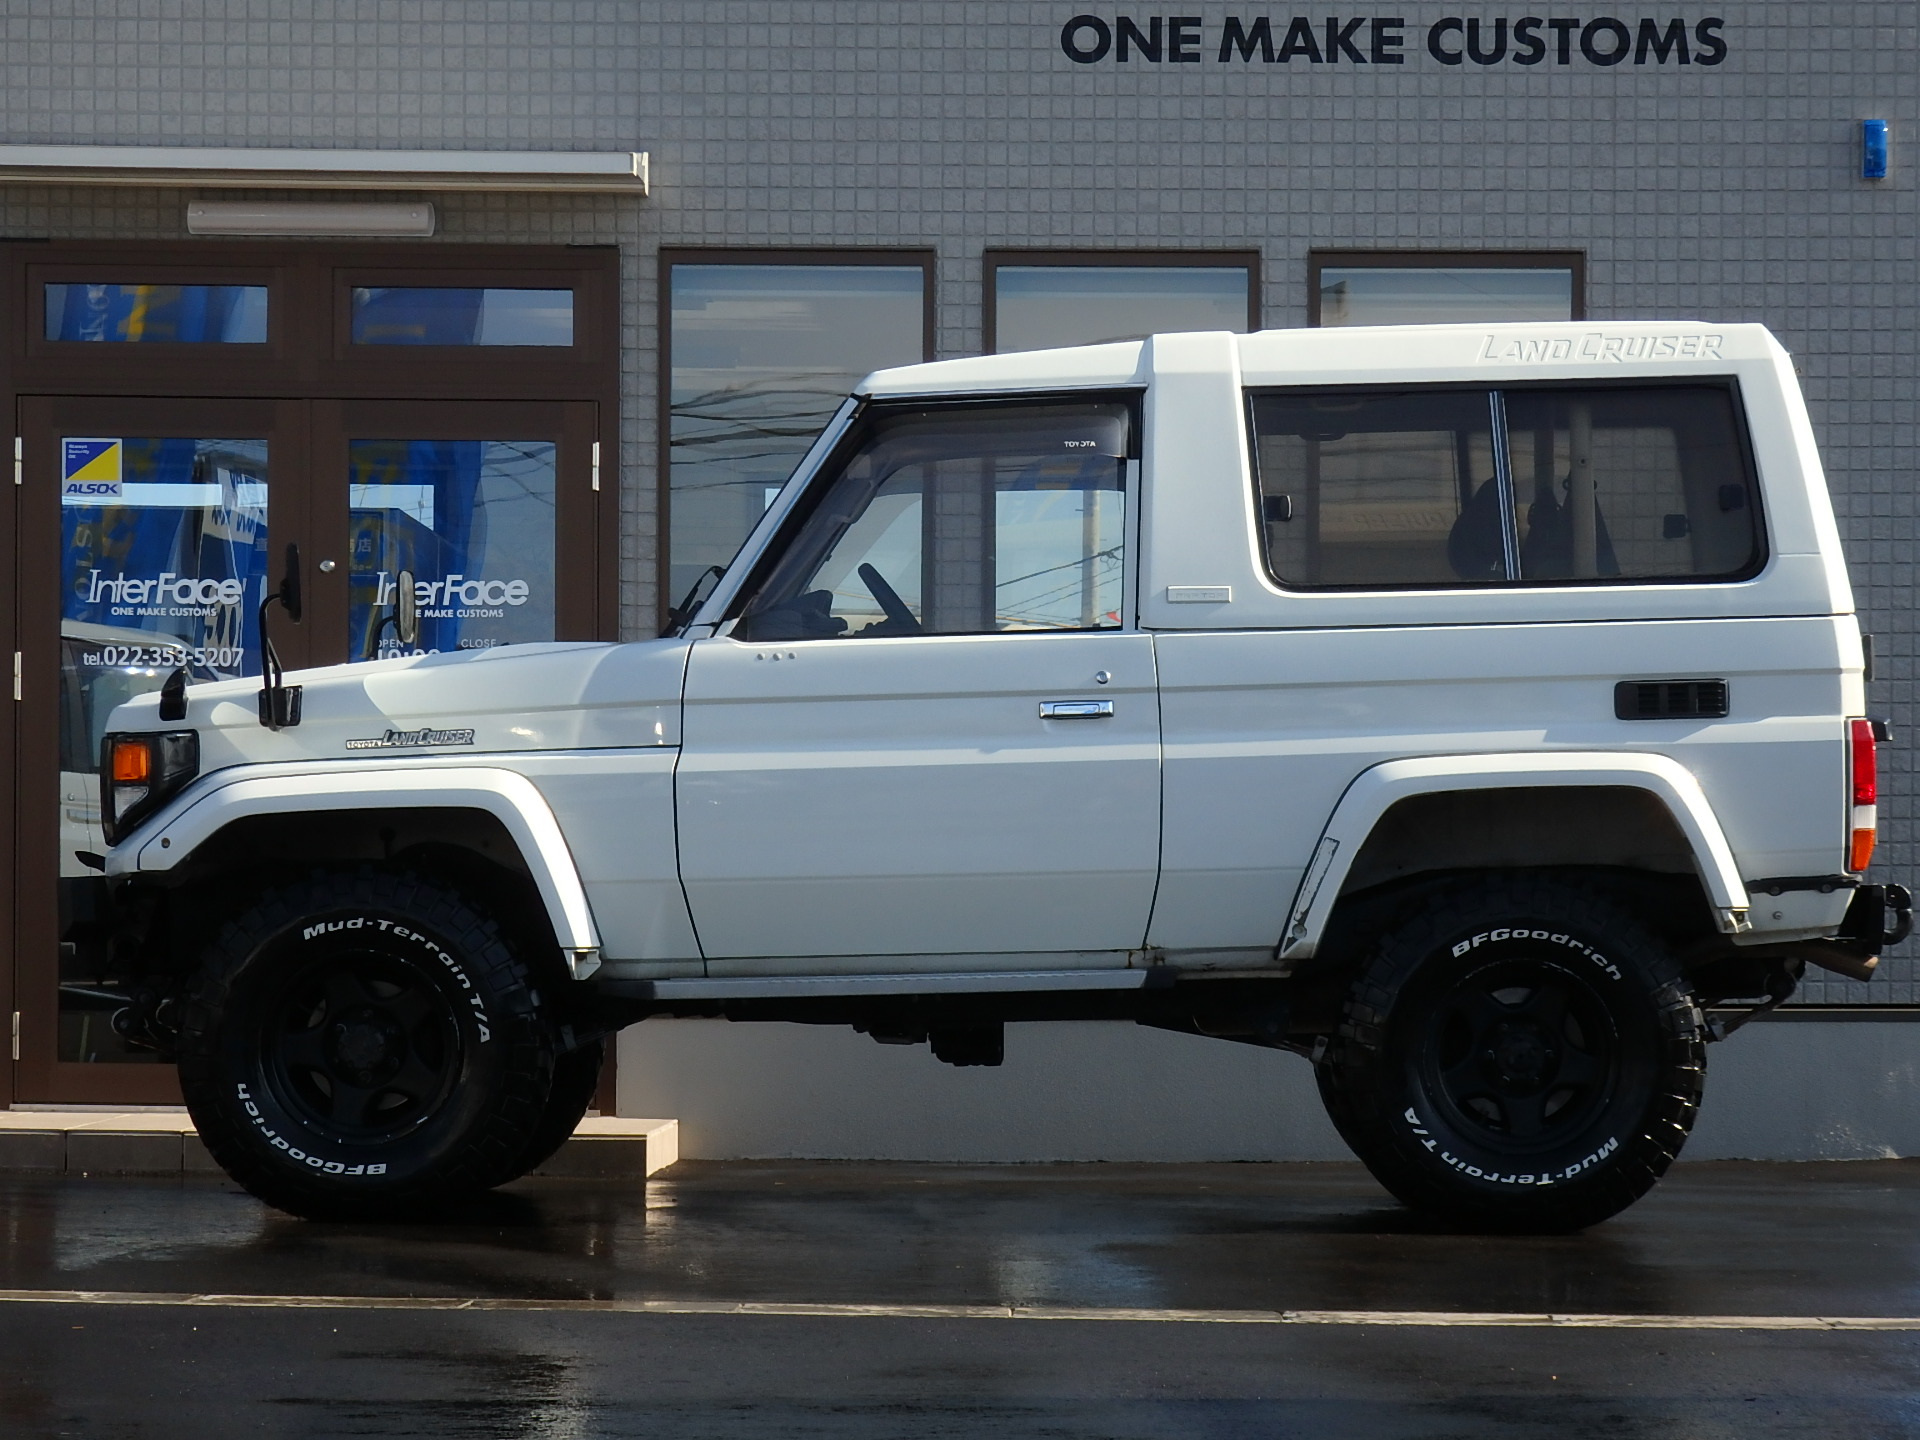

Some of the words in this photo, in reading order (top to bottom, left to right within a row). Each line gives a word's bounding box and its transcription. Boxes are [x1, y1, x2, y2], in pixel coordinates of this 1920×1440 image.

[1060, 16, 1201, 64] ONE
[1219, 17, 1404, 65] MAKE
[1427, 16, 1728, 67] CUSTOMS
[1476, 334, 1571, 363] LAND
[1575, 332, 1723, 363] CRUISER
[66, 483, 118, 494] ALSOK
[85, 569, 242, 605] InterFace
[372, 572, 529, 606] InerFace
[111, 607, 134, 616] ONE
[137, 607, 166, 616] MAKE
[169, 607, 217, 617] CUSTOMS
[424, 609, 454, 618] MAKE
[456, 609, 504, 618] CUSTOMS
[83, 647, 245, 667] tel.022-353-5207
[381, 729, 420, 746] LAND
[418, 728, 475, 745] CRUISER
[1451, 928, 1622, 981] BFGoodrich
[303, 917, 472, 989] Mud-Terrain
[469, 992, 491, 1044] T/A
[237, 1083, 388, 1176] BFGoodrich
[1404, 1106, 1437, 1152] T/A
[1440, 1136, 1620, 1186] Mud-Terrain
